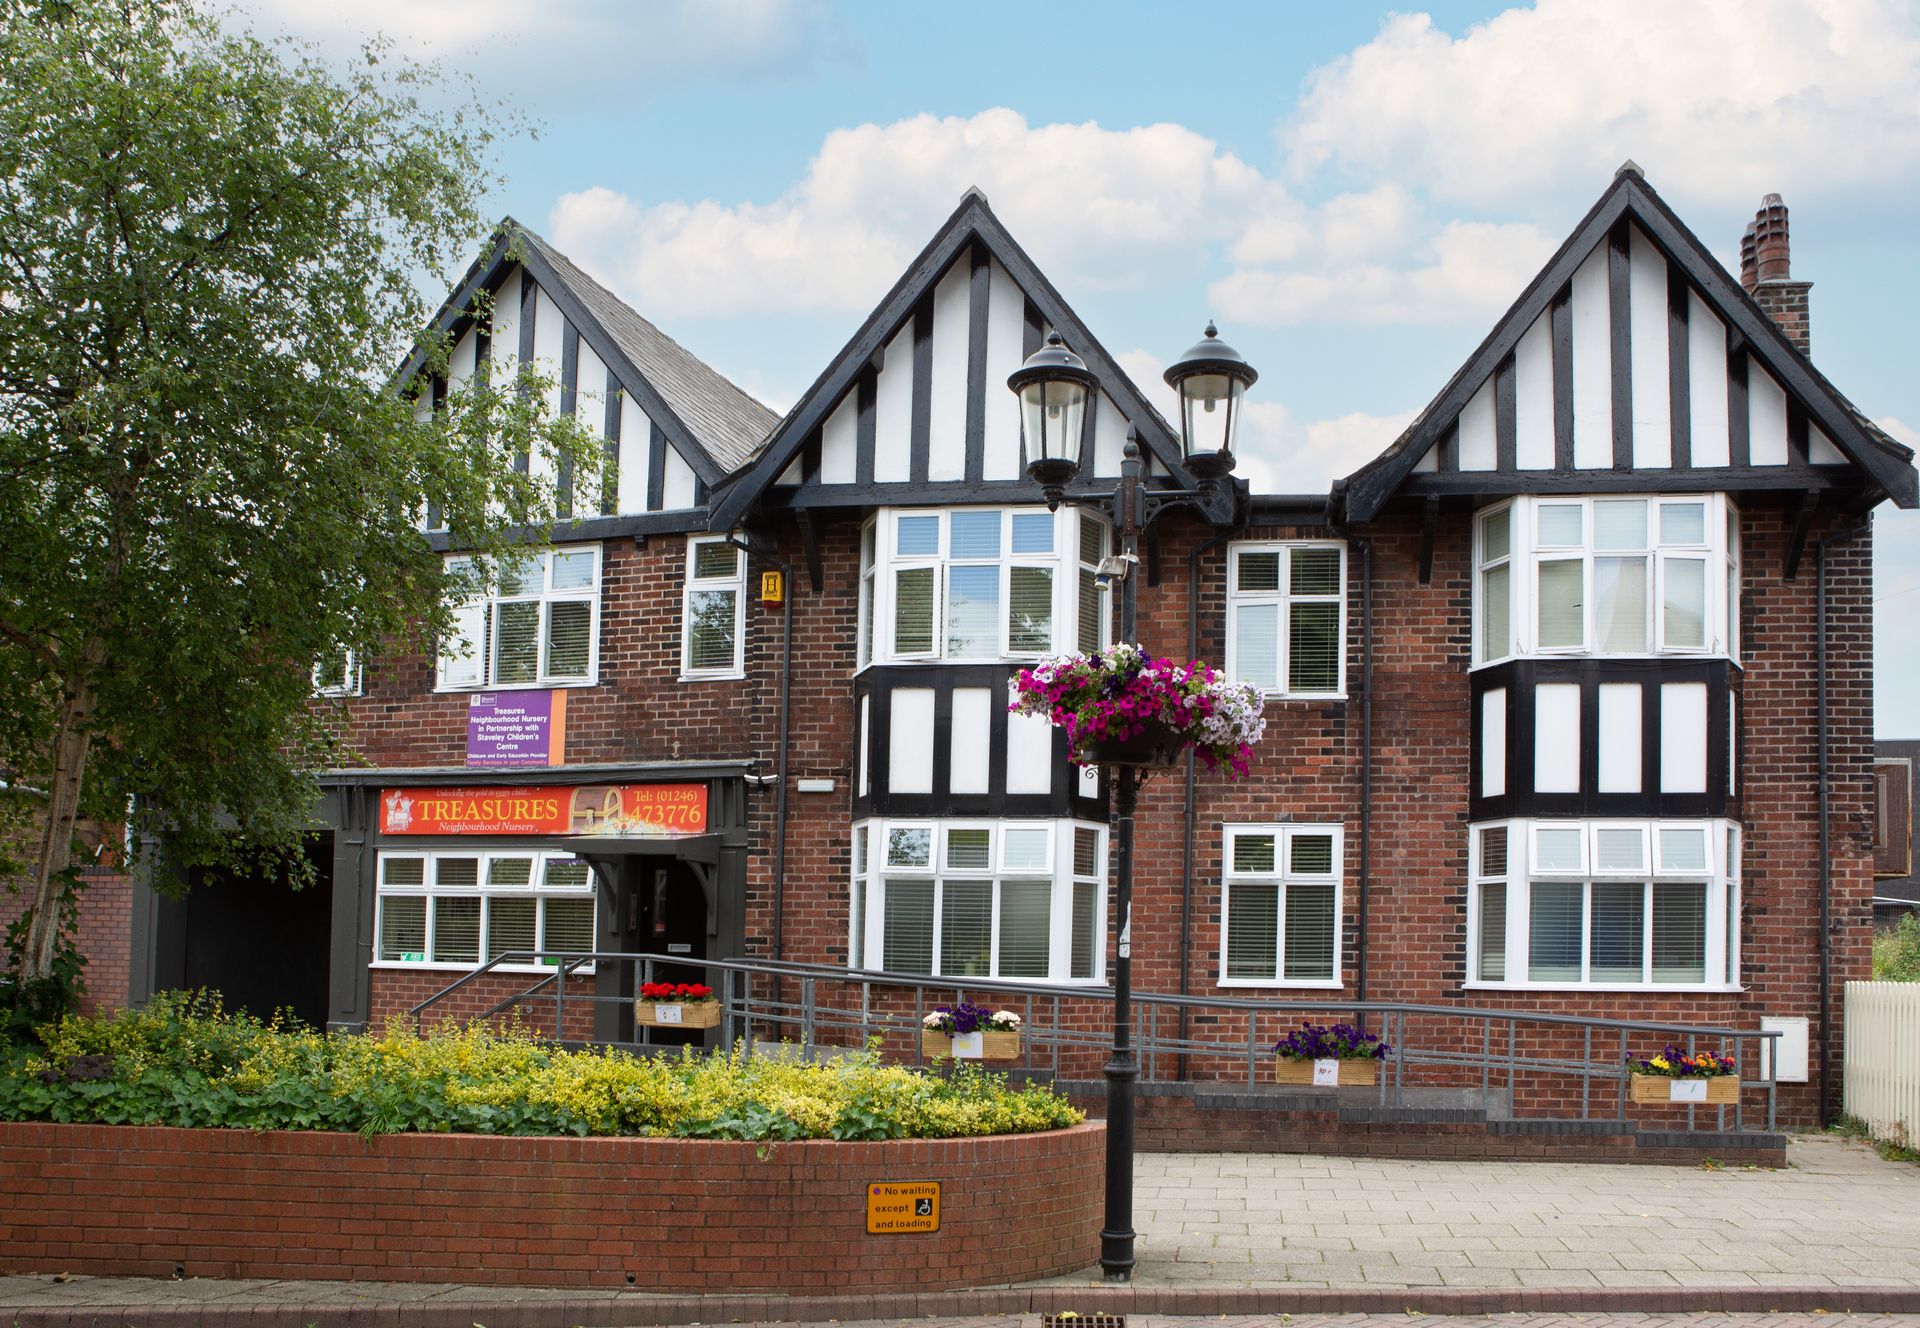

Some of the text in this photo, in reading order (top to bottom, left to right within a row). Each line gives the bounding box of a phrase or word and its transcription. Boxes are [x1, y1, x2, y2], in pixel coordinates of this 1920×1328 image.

[494, 707, 525, 715] Treasures
[470, 715, 548, 724] Neighbourhood Nursery
[486, 724, 523, 732] Partnership
[477, 734, 505, 742] Staveley
[436, 789, 464, 797] Unlocking
[633, 790, 698, 802] Tel: (01246)
[417, 799, 558, 820] TREASURES
[630, 804, 701, 824] 473776
[438, 821, 535, 832] Neighbourhood Nursery
[885, 1186, 936, 1195] No waiting
[875, 1204, 909, 1213] except
[875, 1219, 931, 1228] and loading
